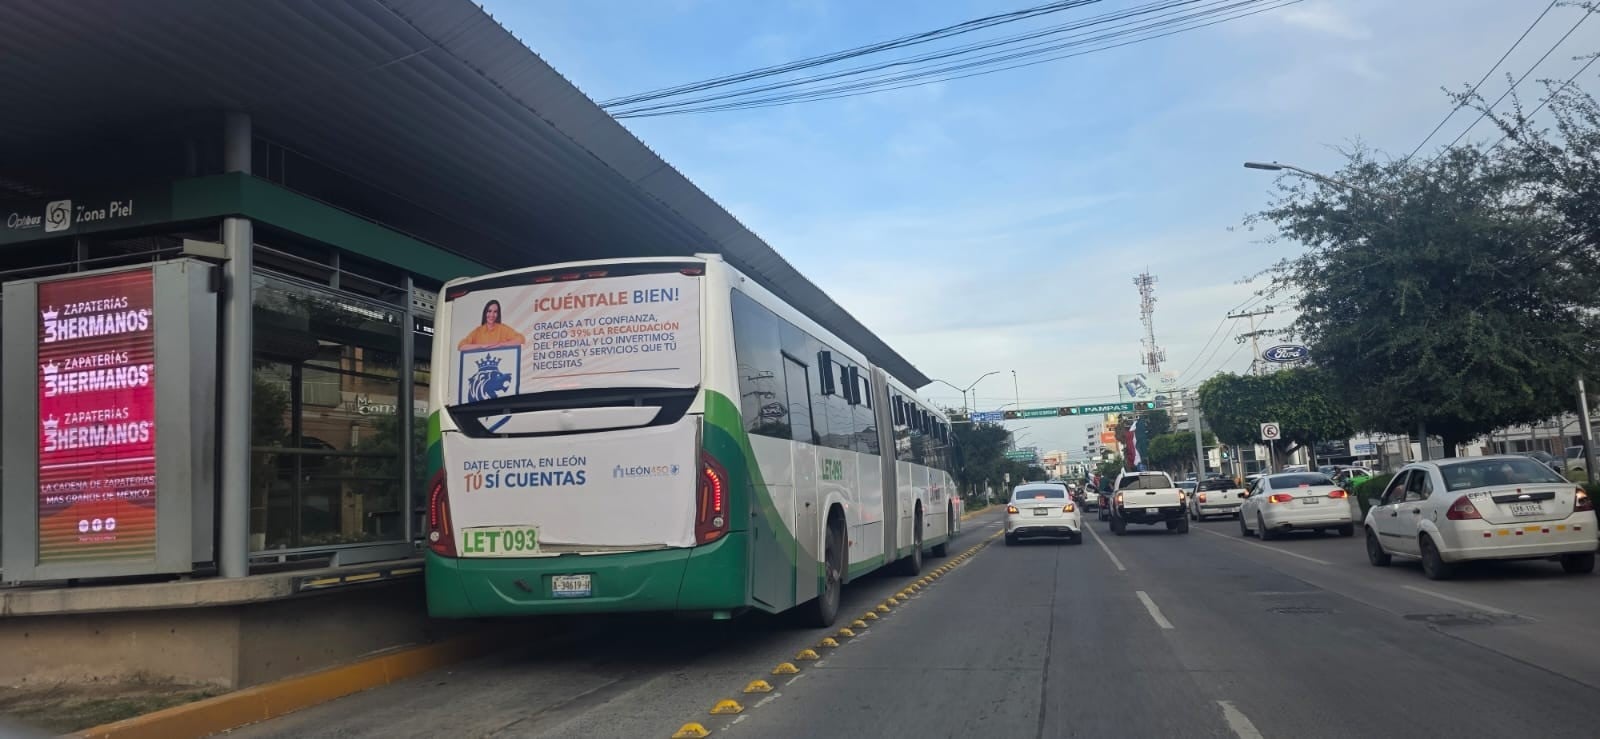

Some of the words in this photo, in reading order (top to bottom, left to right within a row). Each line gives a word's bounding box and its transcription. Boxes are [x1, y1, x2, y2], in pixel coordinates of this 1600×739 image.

[76, 206, 105, 223] Zona
[109, 200, 132, 218] Piel
[64, 296, 128, 315] ZAPATERÍAS
[534, 291, 628, 312] ¡CUÉNTALE
[633, 288, 679, 304] BIEN!
[533, 329, 568, 341] CRECIÓ
[570, 329, 591, 338] 39%
[593, 328, 605, 336] LA
[607, 321, 679, 335] RECAUDACIÓN
[534, 320, 574, 331] GRACIAS
[576, 319, 582, 328] A
[584, 318, 596, 326] TU
[598, 313, 658, 326] CONFIANZA,
[533, 342, 551, 351] DEL
[552, 339, 590, 349] PREDIAL
[592, 337, 599, 346] Y
[600, 336, 614, 345] LO
[615, 332, 675, 344] INVERTIMOS
[64, 350, 128, 370] ZAPATERÍAS
[533, 352, 546, 361] EN
[548, 349, 579, 359] OBRAS
[582, 348, 588, 357] Y
[590, 344, 639, 356] SERVICIOS
[641, 343, 662, 353] QUE
[533, 359, 583, 371] NECESITAS
[64, 406, 129, 425] ZAPATERÍAS
[1084, 405, 1128, 413] PAMPAS
[463, 461, 489, 471] DATE
[491, 458, 536, 470] CUENTA,
[538, 457, 554, 467] EN
[556, 454, 586, 467] LEÓN
[53, 481, 88, 491] CADENA
[90, 479, 101, 488] DE
[464, 471, 482, 493] TÚ
[485, 469, 500, 489] SÍ
[504, 470, 586, 488] CUENTAS
[65, 493, 100, 503] GRANDE
[102, 493, 114, 501] DE
[463, 531, 500, 553] LET
[503, 529, 536, 551] 093
